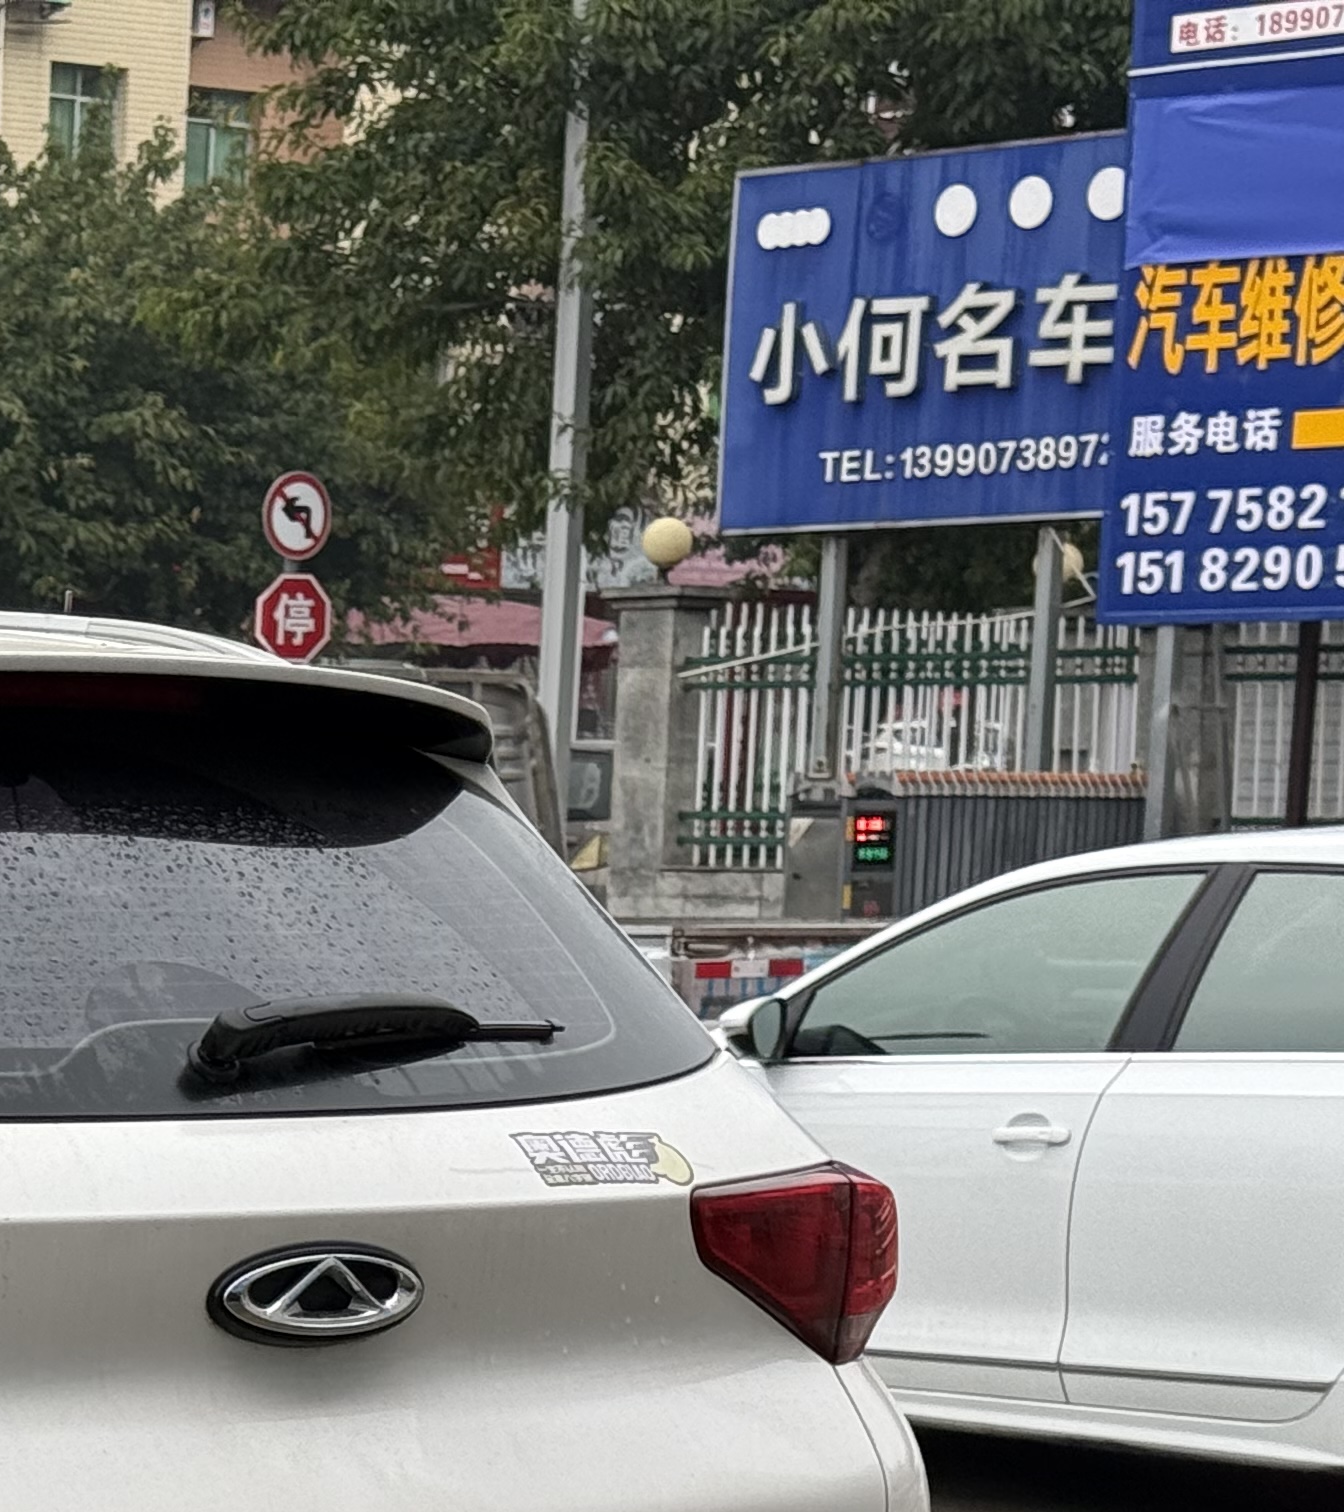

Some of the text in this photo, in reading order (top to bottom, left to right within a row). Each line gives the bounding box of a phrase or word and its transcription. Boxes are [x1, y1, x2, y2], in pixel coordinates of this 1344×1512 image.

[748, 272, 1119, 405] 小何名车
[1127, 256, 1344, 375] 汽车维修
[1127, 407, 1282, 458] 服务电话
[1120, 483, 1328, 537] 157 7582
[1115, 550, 1185, 595] 151
[1199, 544, 1324, 592] 8290
[273, 592, 316, 646] 停
